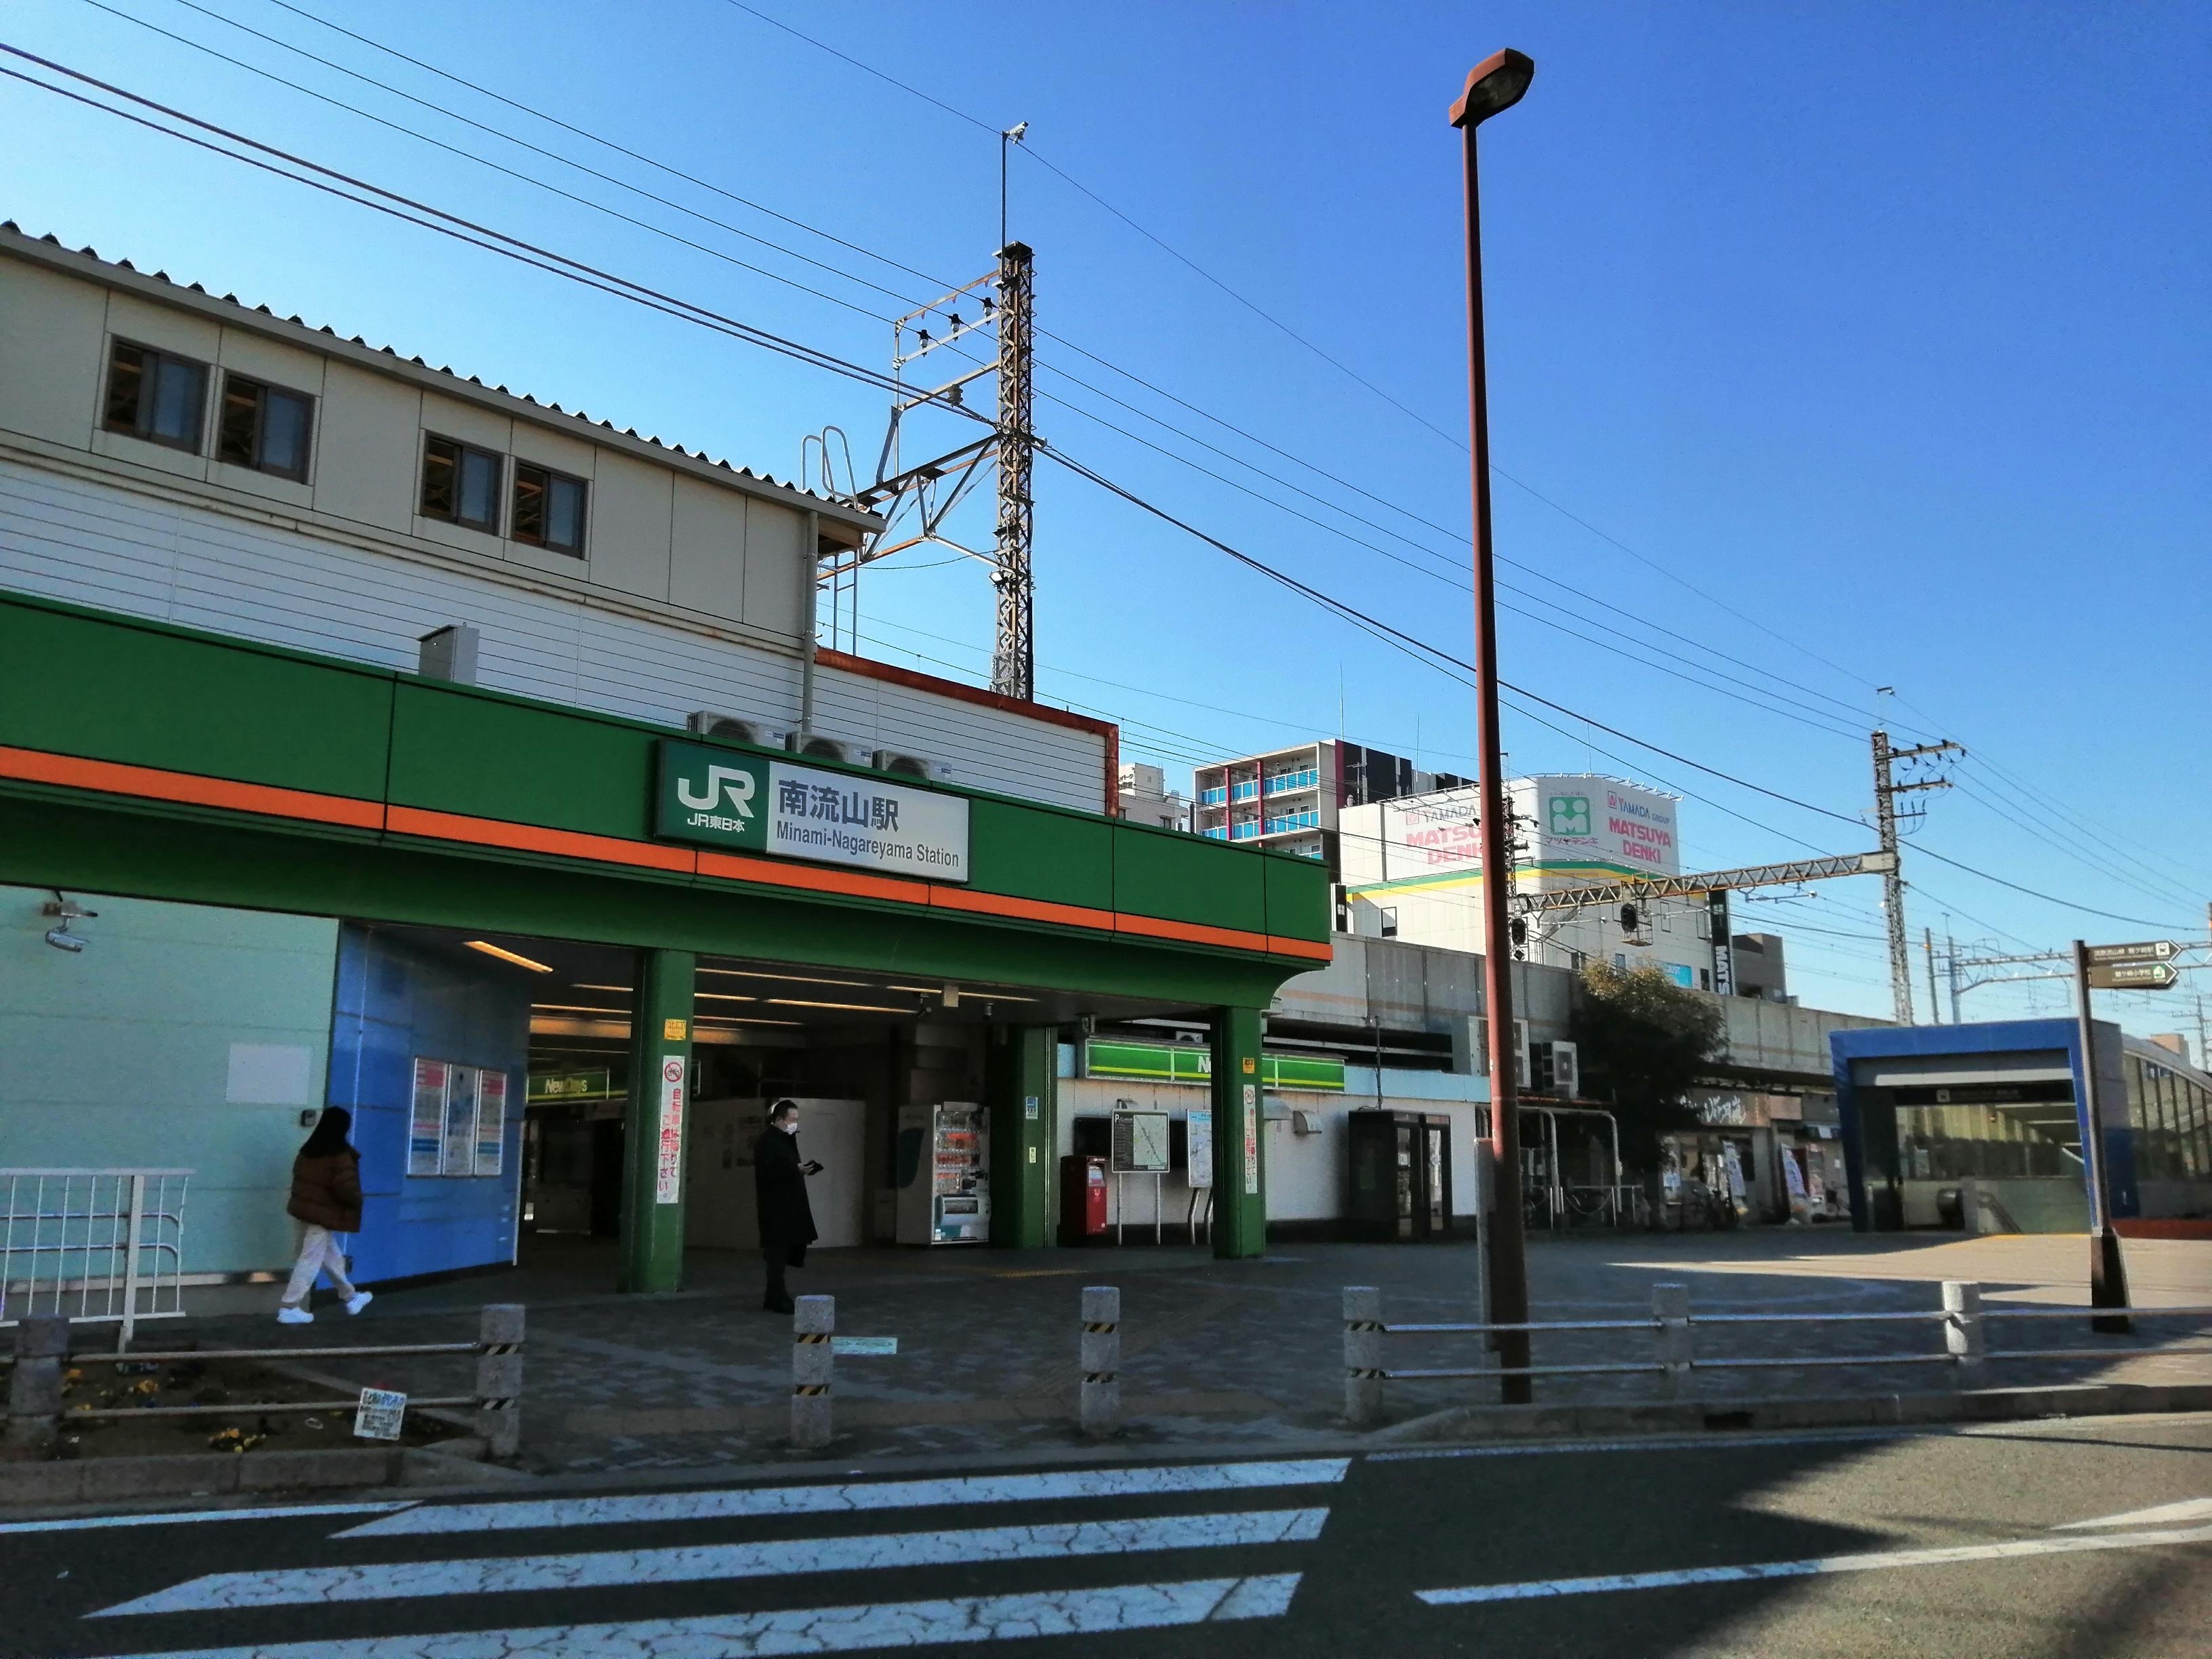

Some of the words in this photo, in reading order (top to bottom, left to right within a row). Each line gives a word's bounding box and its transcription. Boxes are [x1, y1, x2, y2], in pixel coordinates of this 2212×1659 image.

[678, 764, 755, 818] JR
[779, 779, 899, 832] 南流山駅
[687, 813, 745, 833] JR東日本
[1618, 797, 1650, 819] YAMADA
[1652, 813, 1671, 825] GROUP
[777, 819, 913, 859] Minami-Nagareyama
[916, 844, 959, 868] Station
[1406, 825, 1482, 847] MATSU
[1609, 817, 1672, 847] MATSUYA
[1622, 840, 1661, 864] DENKI
